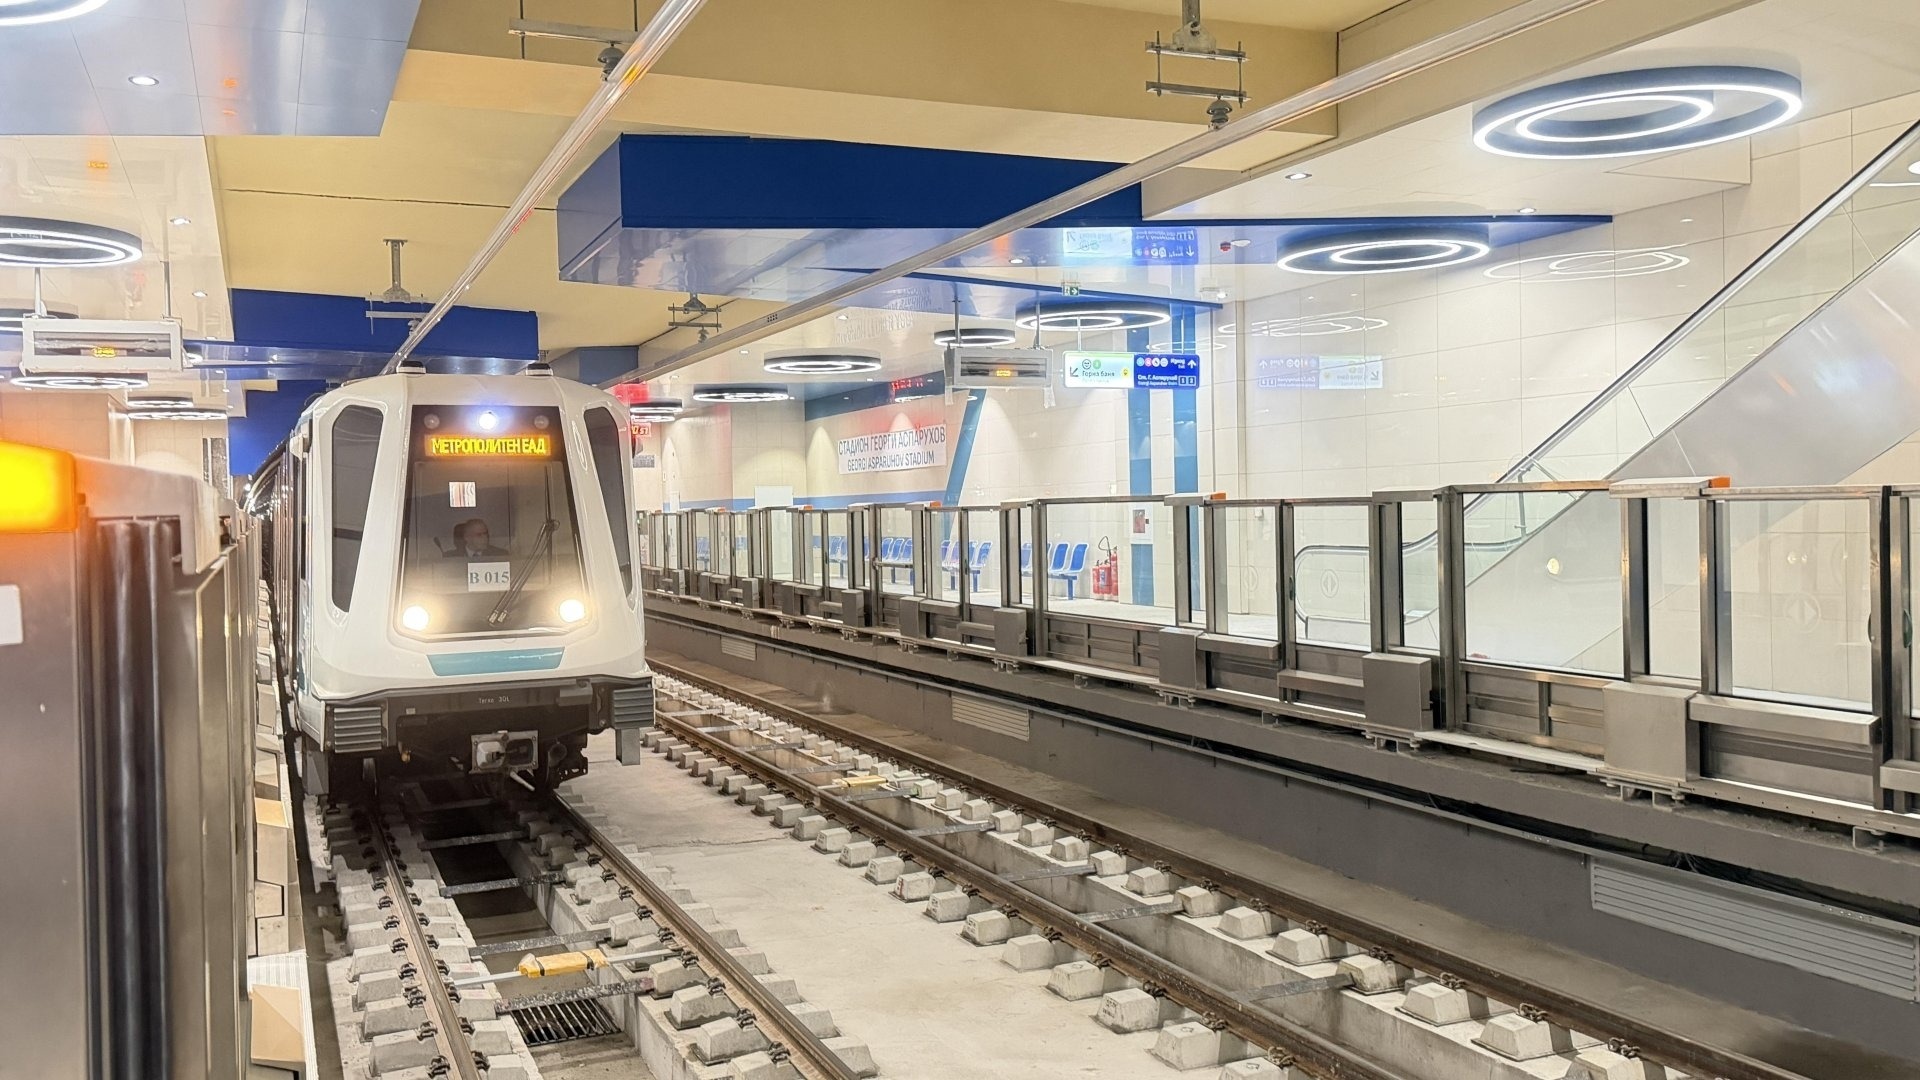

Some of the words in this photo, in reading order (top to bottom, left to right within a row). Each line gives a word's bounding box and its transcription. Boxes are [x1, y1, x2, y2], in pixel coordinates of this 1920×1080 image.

[432, 437, 521, 454] МЕТРОПОЛИТЕН
[522, 437, 546, 454] ЕАД
[838, 437, 869, 456] СТАДИОН
[870, 433, 897, 451] ГЕОРГИ
[897, 426, 946, 448] АСПАРУХОВ
[847, 457, 868, 472] GEORGI
[868, 454, 904, 469] ASPARUHOV
[905, 450, 935, 465] STADIUM
[484, 571, 510, 584] 015
